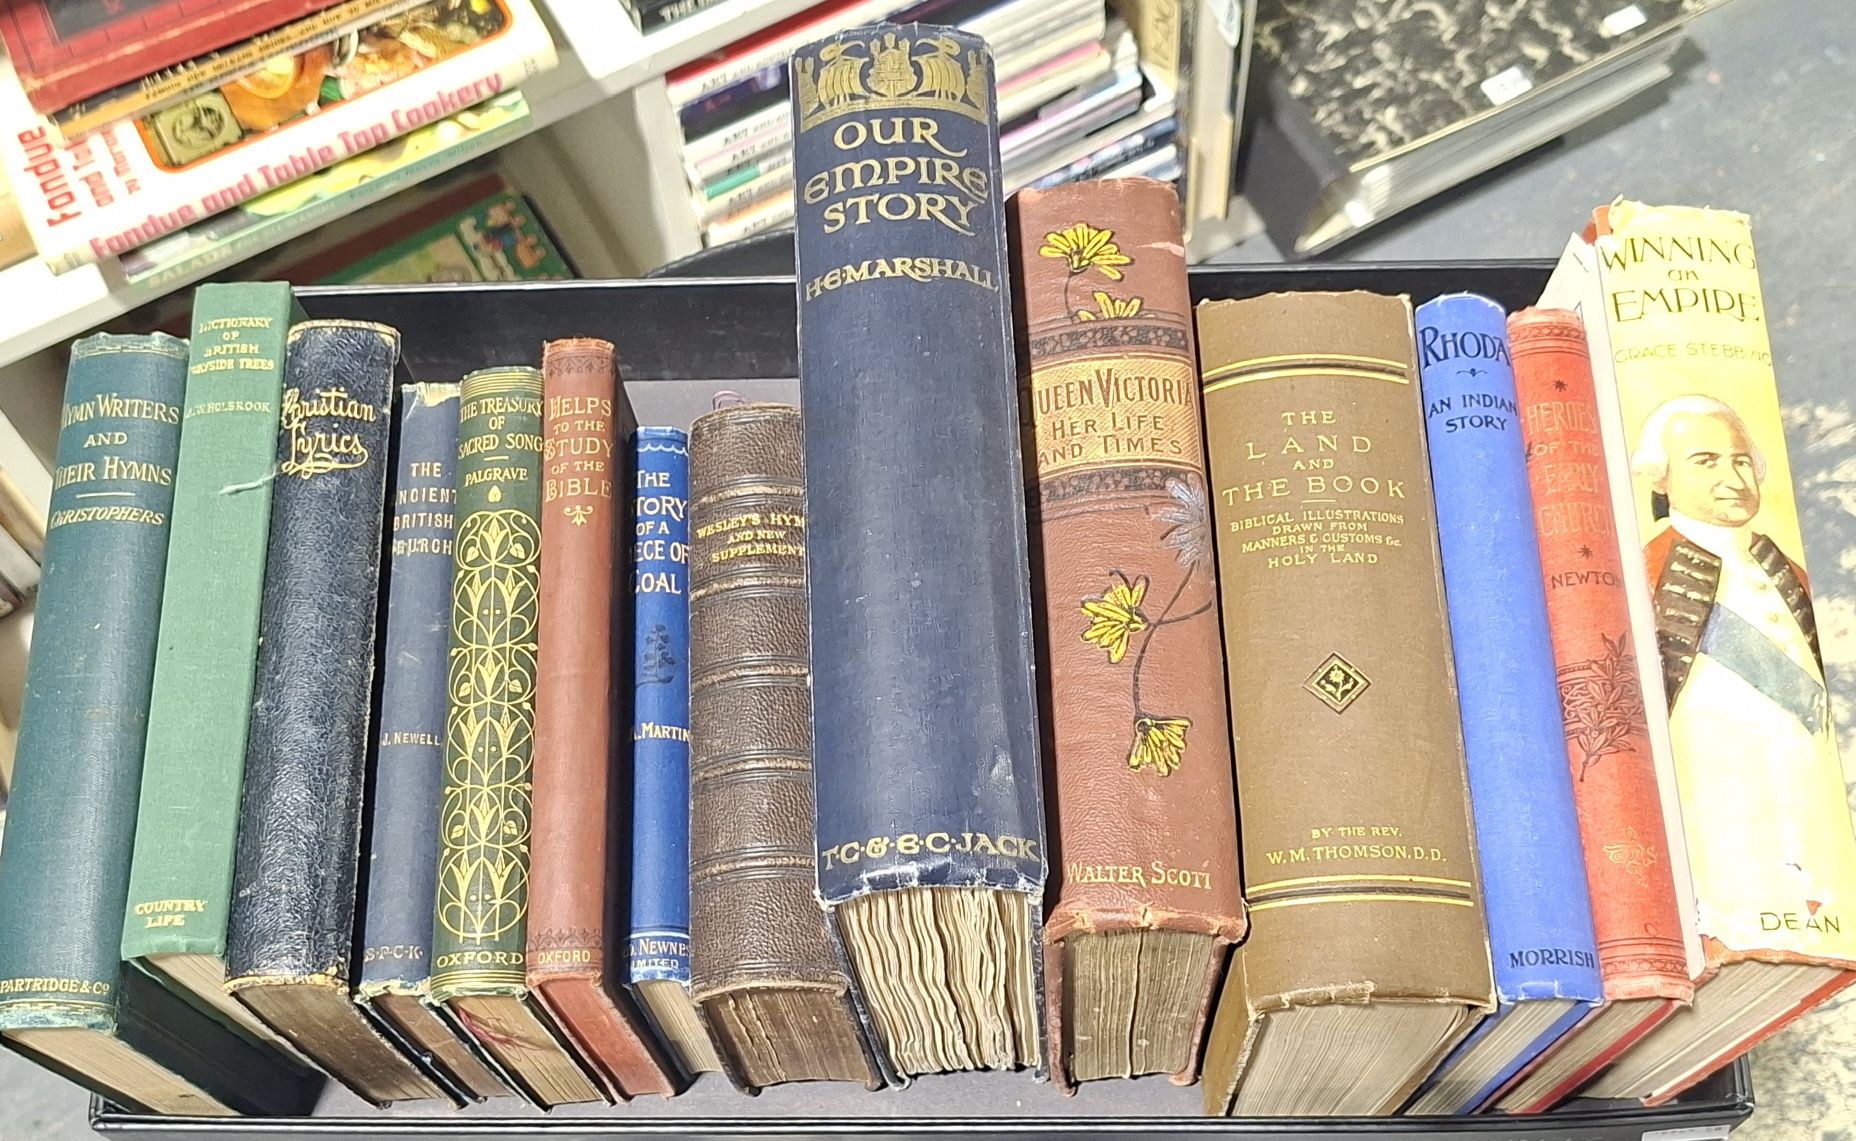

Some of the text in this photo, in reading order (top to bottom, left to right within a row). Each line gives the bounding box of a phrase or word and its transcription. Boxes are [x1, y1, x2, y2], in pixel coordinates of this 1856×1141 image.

[833, 117, 968, 157] OUR
[17, 126, 82, 227] Fondue
[89, 203, 197, 261] Fondue
[203, 173, 258, 213] and
[258, 143, 338, 195] Table
[338, 123, 390, 155] Top
[391, 73, 503, 132] Cookery
[804, 157, 989, 204] EMPIRE
[824, 193, 981, 236] STORY
[1600, 237, 1756, 272] WINNING
[1667, 269, 1699, 281] an
[1611, 288, 1759, 322] EMPIRE
[223, 331, 240, 341] OF
[1419, 326, 1510, 369] RHODA
[239, 357, 275, 370] TREES
[1095, 367, 1194, 409] VICTORIA
[96, 392, 180, 425] WRITERS
[282, 387, 376, 429] Christian
[460, 397, 543, 424] THE TREASURY
[549, 396, 612, 421] HELPS
[1282, 410, 1336, 425] THE
[1428, 394, 1517, 418] AN INDIAN
[488, 416, 505, 430] OF
[553, 420, 605, 435] TO THE
[1052, 411, 1165, 440] HER LIFE
[1446, 415, 1507, 433] STORY
[1525, 401, 1598, 435] HEROES
[83, 432, 128, 448] AND
[282, 421, 369, 480] Lyrics
[458, 433, 544, 460] SACRED SONG
[544, 437, 614, 462] STUDY
[1039, 434, 1182, 466] AND TIMES
[1246, 434, 1372, 460] LAND
[1533, 442, 1560, 457] OF
[102, 455, 172, 486] HYMNS
[411, 462, 442, 477] THE
[551, 461, 605, 475] OF THE
[1292, 458, 1334, 471] AND
[465, 467, 528, 487] PALGRAVE
[636, 470, 671, 488] THE
[1543, 463, 1599, 496] EARLY
[545, 478, 612, 503] BIBLE
[1222, 476, 1405, 506] THE BOOK
[50, 506, 166, 530] CHRISTOPHERS
[634, 496, 687, 522] TORY
[1230, 509, 1404, 532] BIBLICAL ILLUSTRATIONS
[636, 521, 670, 536] OF A
[697, 513, 761, 539] WESLEY'S
[728, 530, 787, 544] AND NEW
[1272, 521, 1368, 535] DRAWN FROM
[1241, 535, 1306, 553] MANNERS
[1309, 534, 1318, 544] &
[1322, 533, 1382, 545] CUSTOMS
[1300, 544, 1345, 553] IN THE
[1268, 553, 1378, 568] HOLY LAND
[394, 732, 442, 746] NEWELL
[1311, 826, 1402, 839] BY THE REV.
[1067, 861, 1212, 890] WALTER SCOTT
[134, 899, 208, 916] COUNTRY
[145, 914, 186, 929] LIFE
[1760, 912, 1840, 933] DEAN
[437, 950, 523, 969] OXFORD
[538, 949, 591, 965] OXFORD
[1510, 948, 1595, 969] MORRISH
